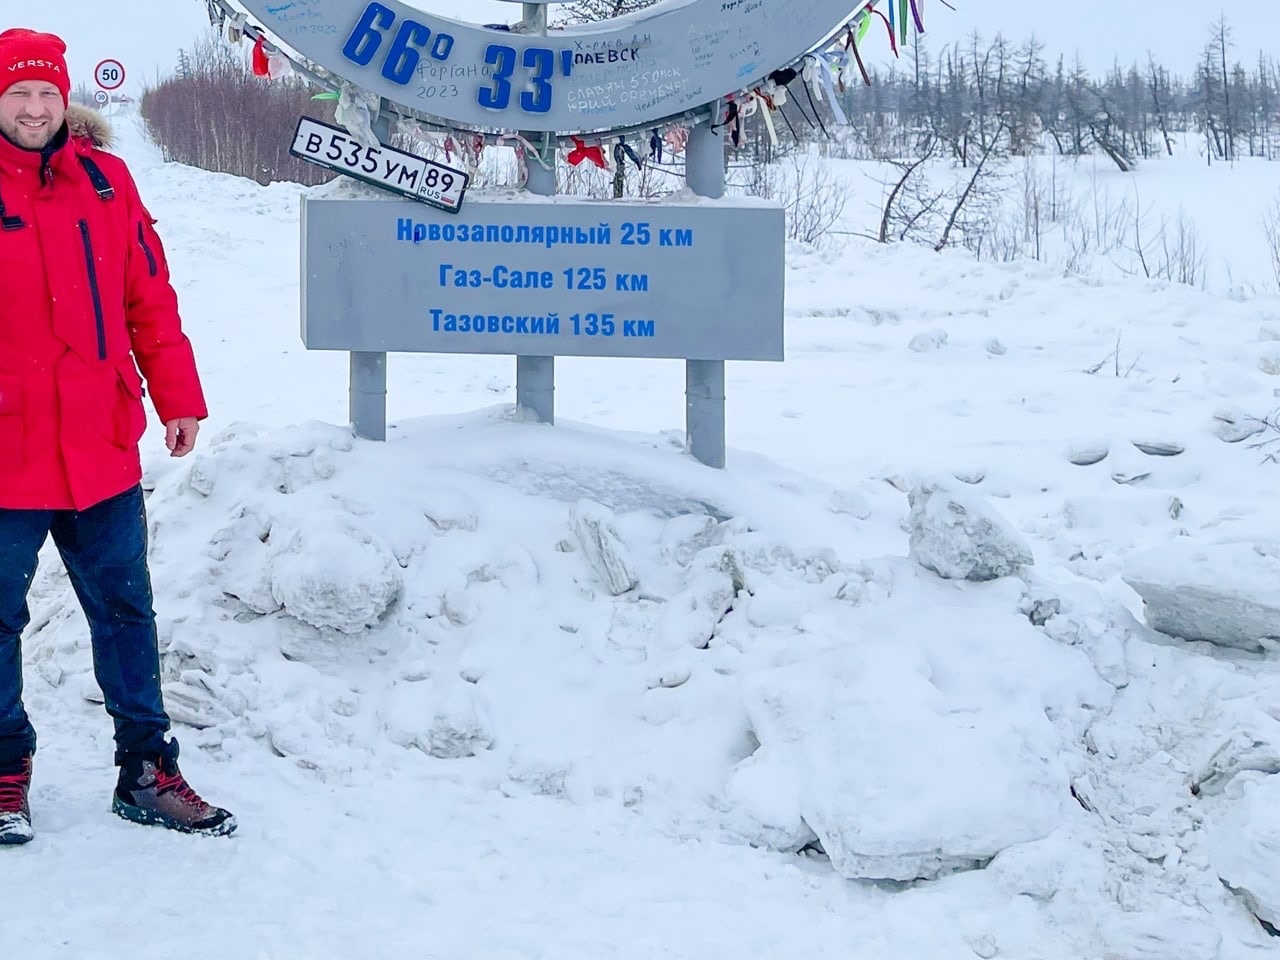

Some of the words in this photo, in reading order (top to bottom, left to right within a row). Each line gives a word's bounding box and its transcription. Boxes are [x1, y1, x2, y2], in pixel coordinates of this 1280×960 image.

[7, 59, 61, 73] VERSTA
[102, 68, 119, 81] 50
[419, 186, 442, 201] RUS
[397, 218, 611, 248] Новозаполярный
[619, 222, 652, 246] 25
[658, 227, 694, 247] км
[438, 263, 555, 290] Газ-Сале
[562, 267, 608, 291] 125
[615, 272, 650, 292] км
[428, 308, 562, 335] Тазовский
[569, 313, 617, 337] 135
[622, 318, 657, 338] км
